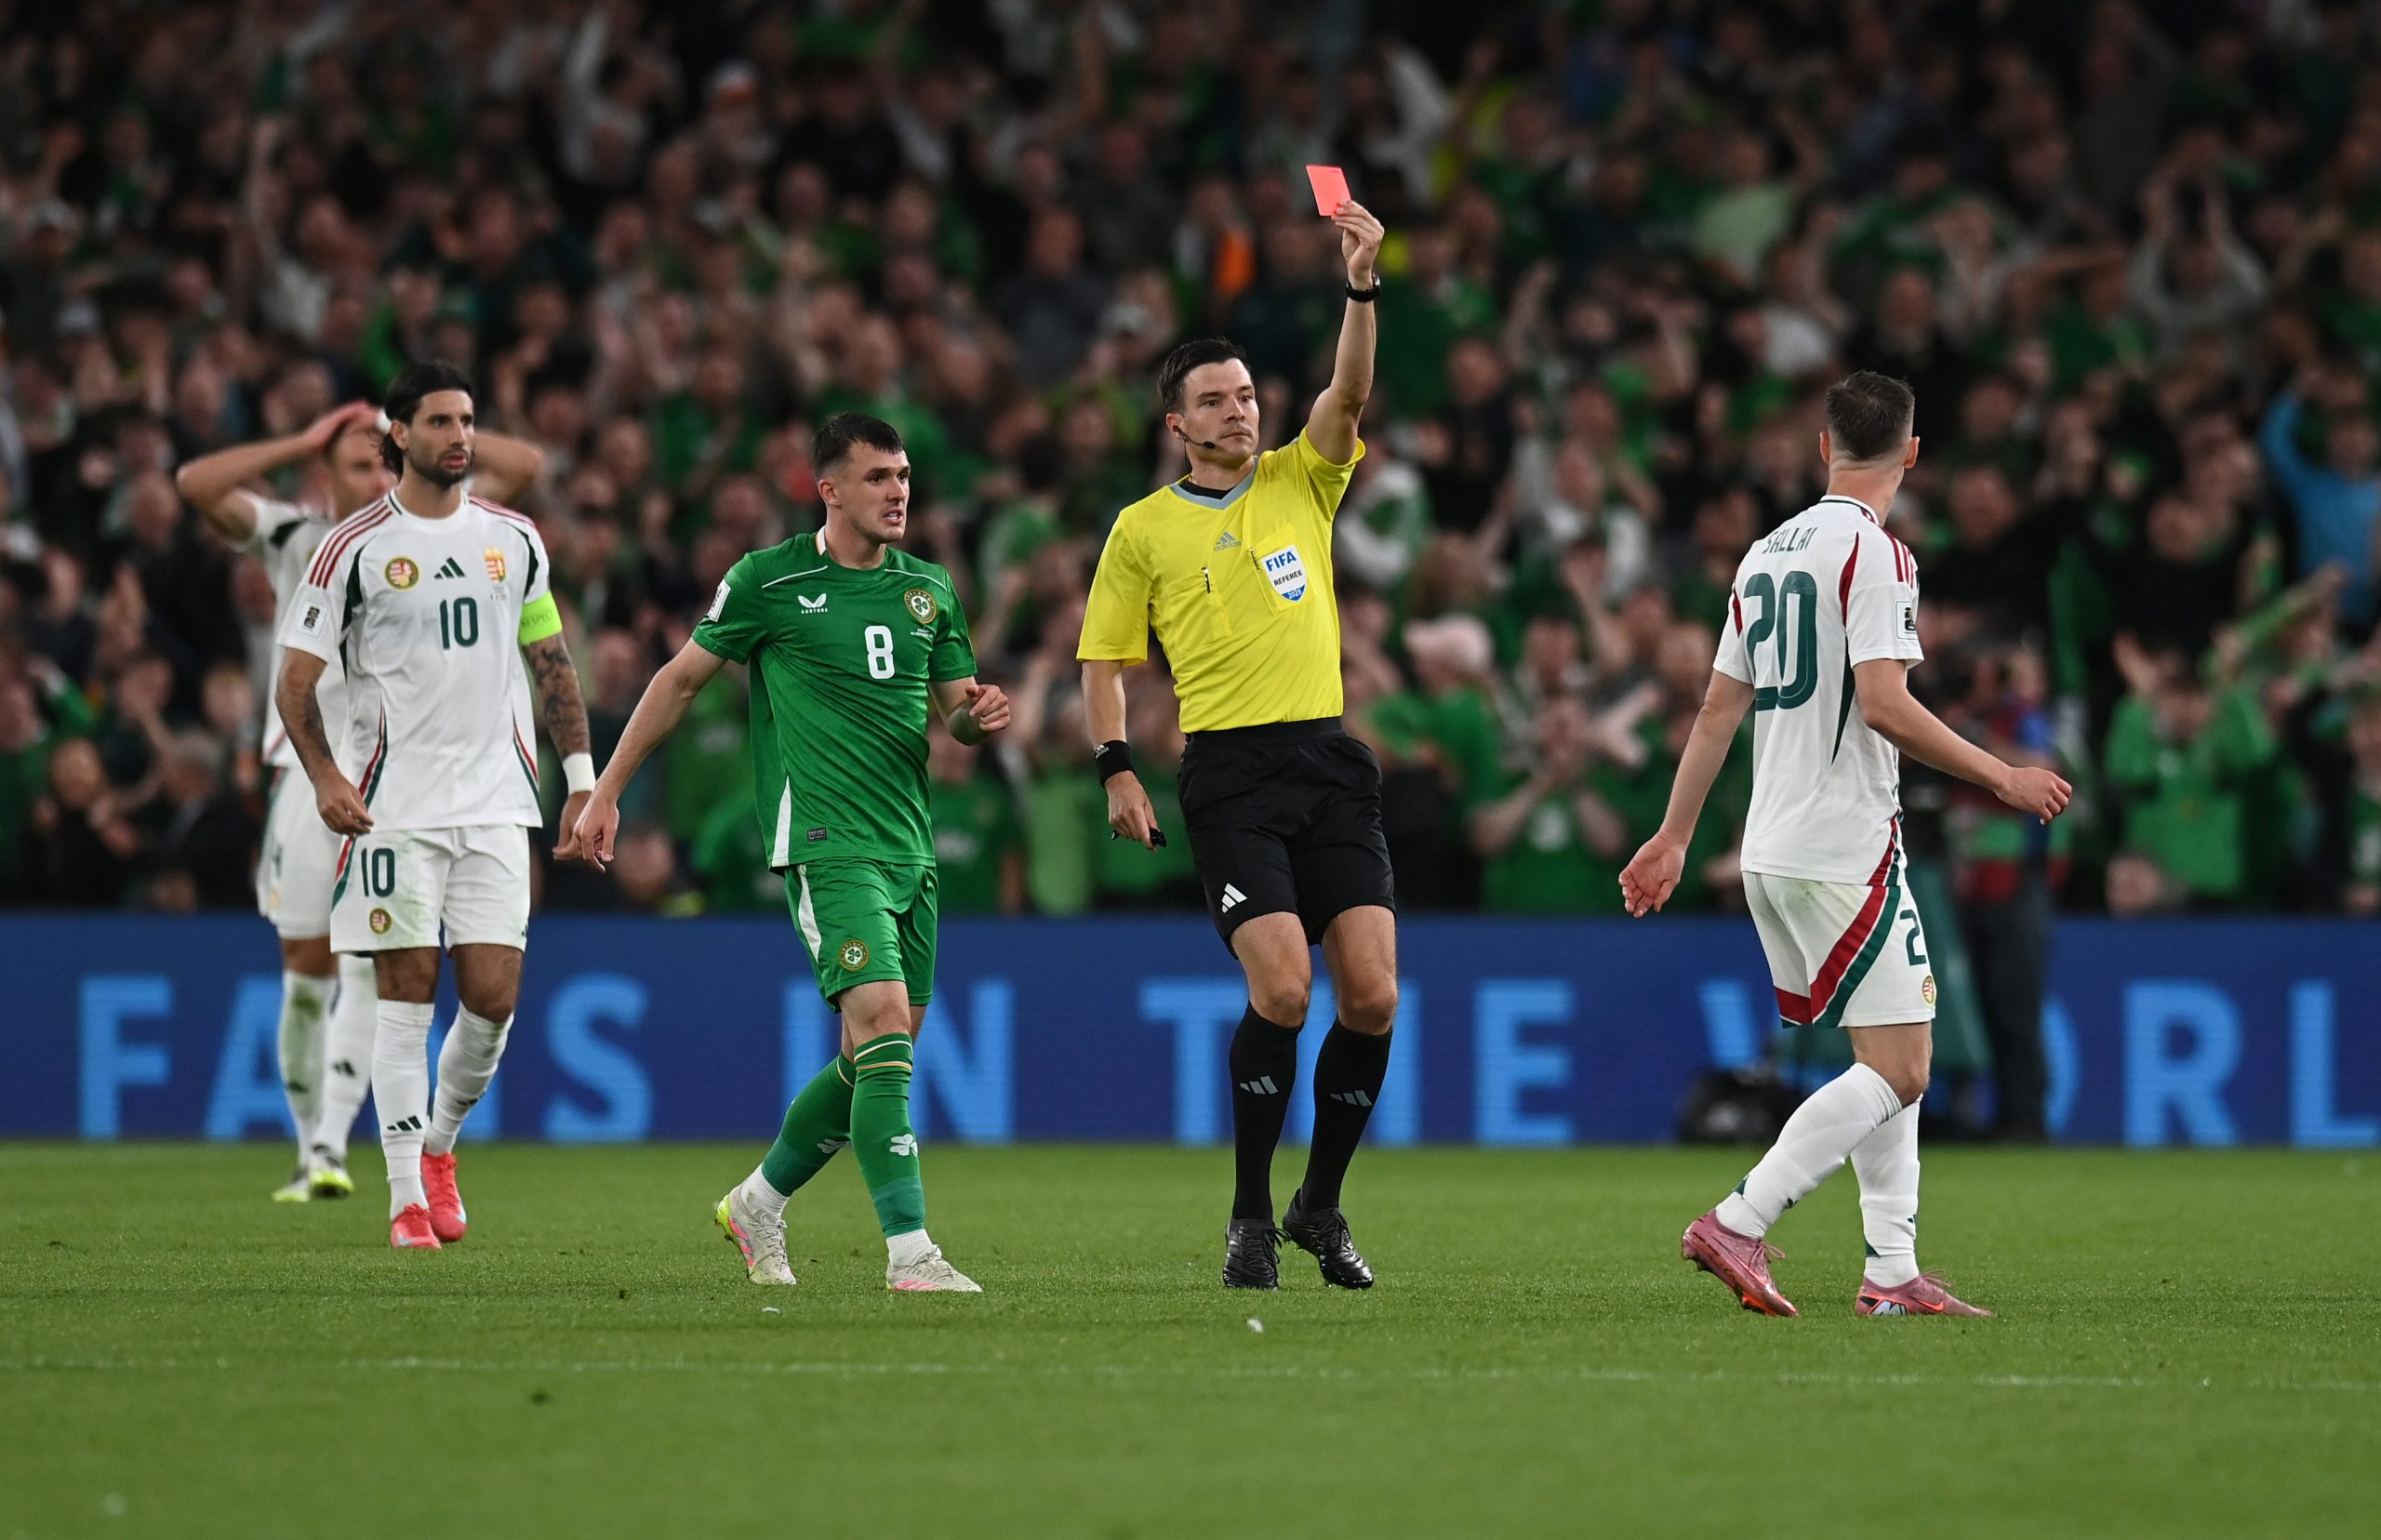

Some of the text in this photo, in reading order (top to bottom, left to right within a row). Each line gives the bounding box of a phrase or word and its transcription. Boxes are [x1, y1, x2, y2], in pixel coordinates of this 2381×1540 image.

[1265, 551, 1297, 572] FIFA
[1762, 527, 1818, 554] SALLAI
[1273, 569, 1303, 586] REFEREE
[439, 597, 479, 650] 10
[1743, 570, 1817, 711] 20
[864, 625, 895, 680] 8
[361, 847, 395, 897] 10
[80, 973, 654, 1141] FAS
[784, 978, 1017, 1141] IN
